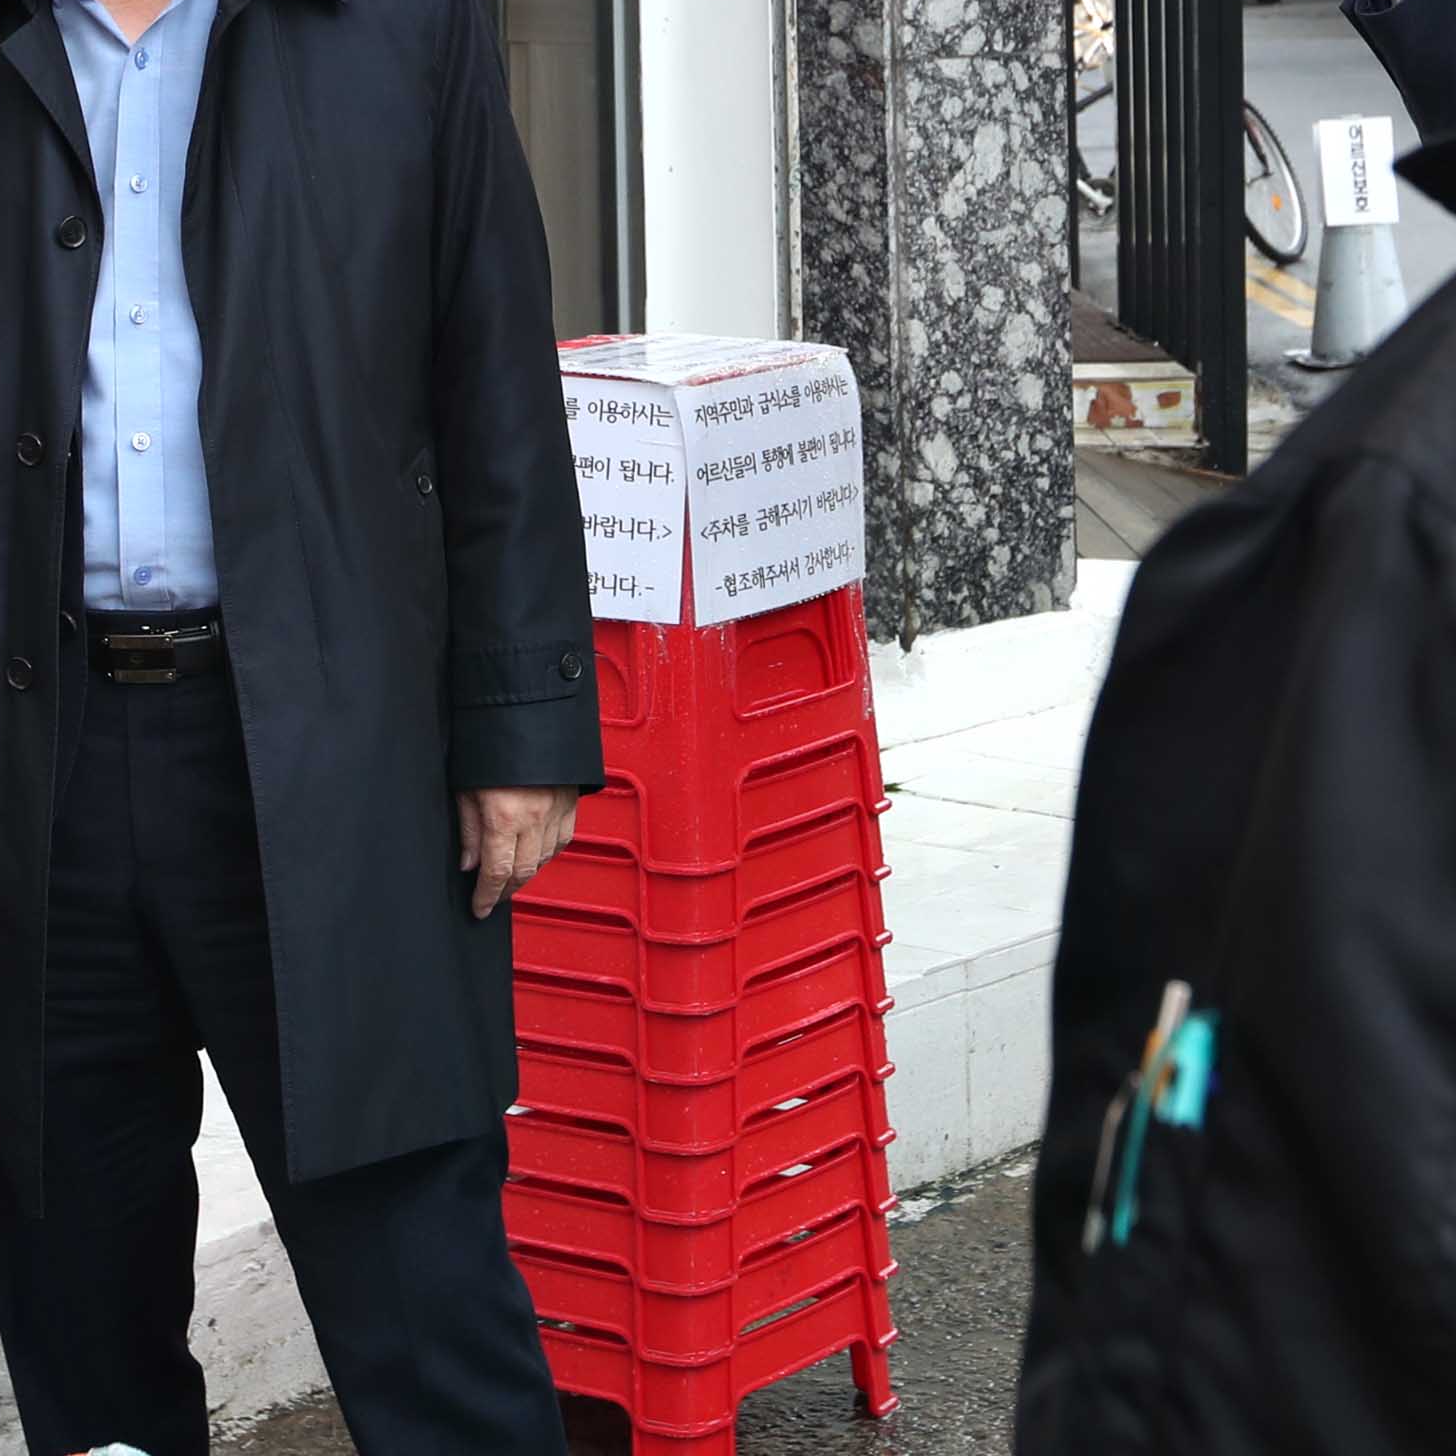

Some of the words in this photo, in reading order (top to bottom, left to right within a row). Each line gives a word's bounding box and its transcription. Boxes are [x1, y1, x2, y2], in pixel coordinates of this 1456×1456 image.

[587, 399, 674, 428] 이용하시는
[695, 394, 754, 428] 지역주민과
[758, 385, 801, 416] 급식소를
[804, 374, 849, 404] 이용하시는
[572, 455, 611, 481] 편이
[618, 459, 675, 485] 됩니다.
[761, 443, 795, 473] 통행에
[797, 434, 827, 464] 불편이
[755, 495, 813, 532] 금해주시기
